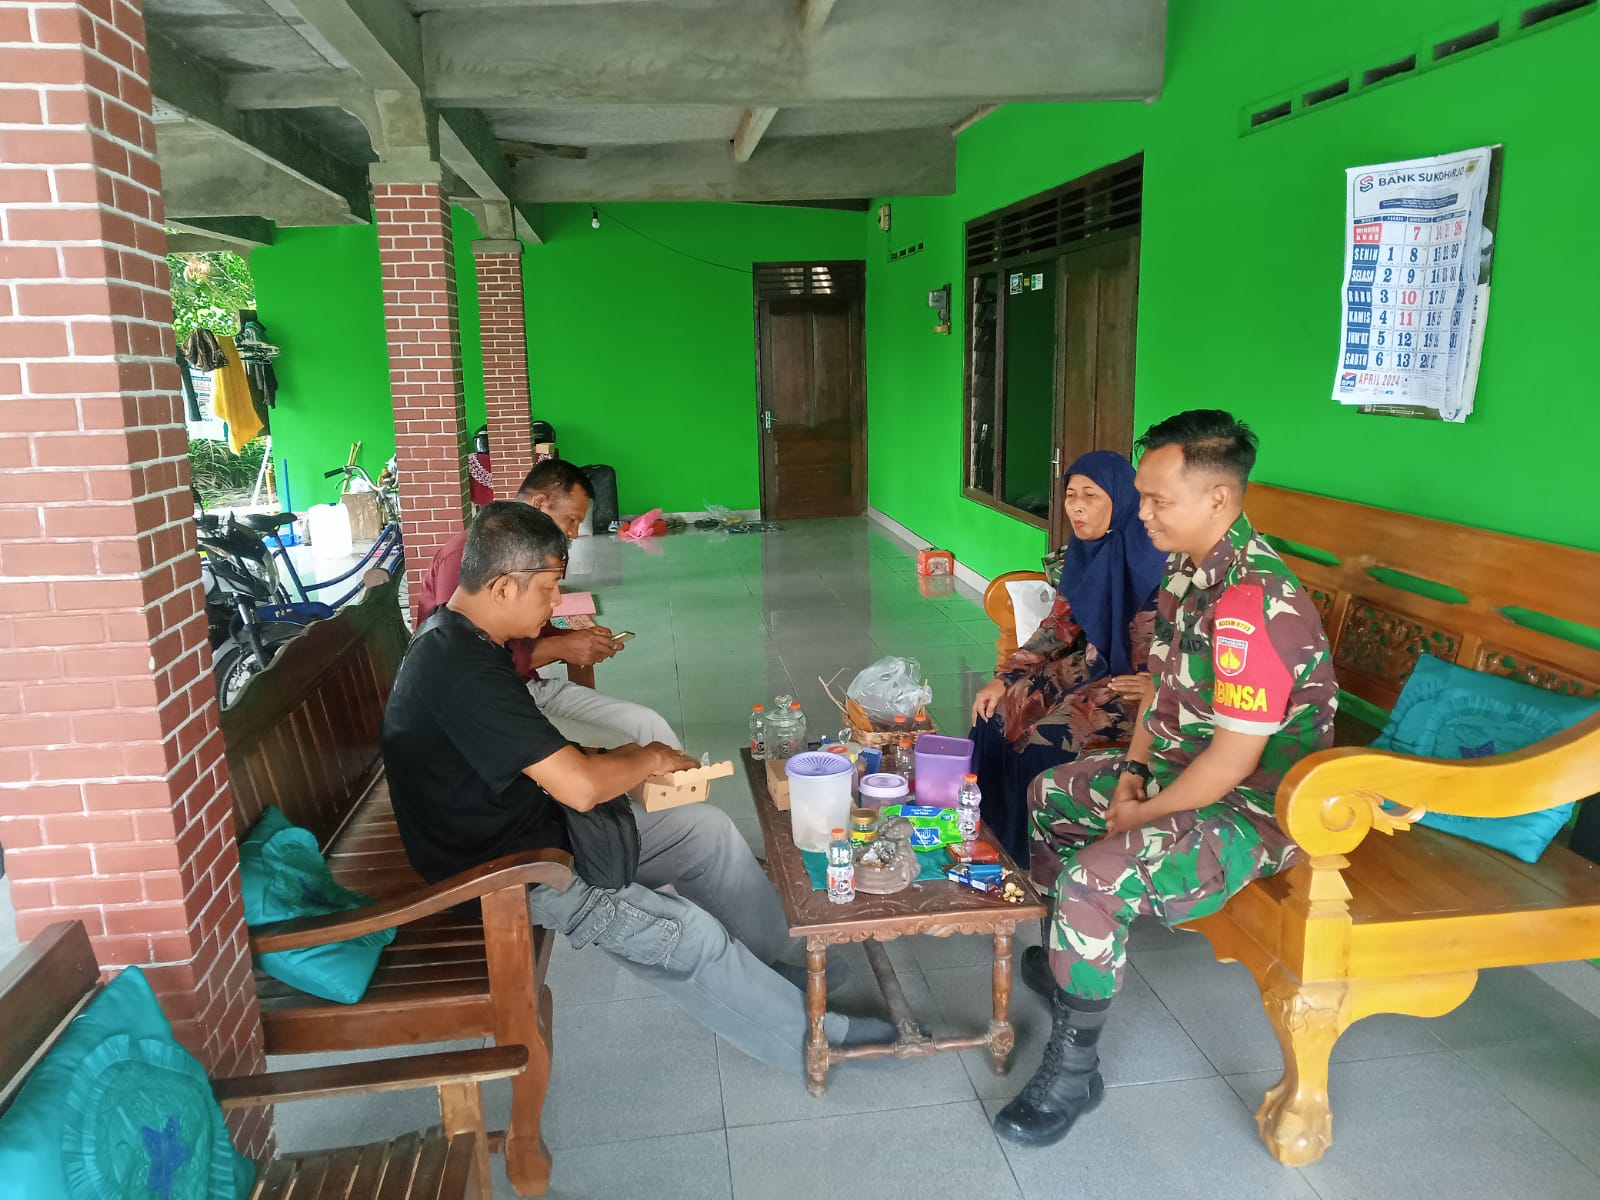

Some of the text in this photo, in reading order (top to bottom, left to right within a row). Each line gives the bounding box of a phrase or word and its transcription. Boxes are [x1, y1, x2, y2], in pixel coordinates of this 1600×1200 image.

[1378, 174, 1415, 187] BANK
[1413, 226, 1421, 240] 7
[1354, 247, 1378, 261] SENIN
[1387, 247, 1394, 262] 1
[1409, 248, 1418, 262] 8
[1352, 269, 1374, 282] SELASA
[1383, 268, 1392, 283] 2
[1407, 269, 1415, 284] 9
[1380, 289, 1389, 303] 3
[1401, 290, 1417, 305] 10
[1349, 311, 1371, 324] KAMIS
[1379, 310, 1388, 325] 4
[1400, 311, 1413, 326] 11
[1378, 331, 1386, 346] 5
[1398, 332, 1412, 347] 12
[1345, 353, 1368, 366] SABTU
[1376, 351, 1384, 367] 6
[1396, 353, 1411, 370] 13
[1358, 373, 1401, 387] APRIL 2024
[1215, 680, 1267, 712] BINSA
